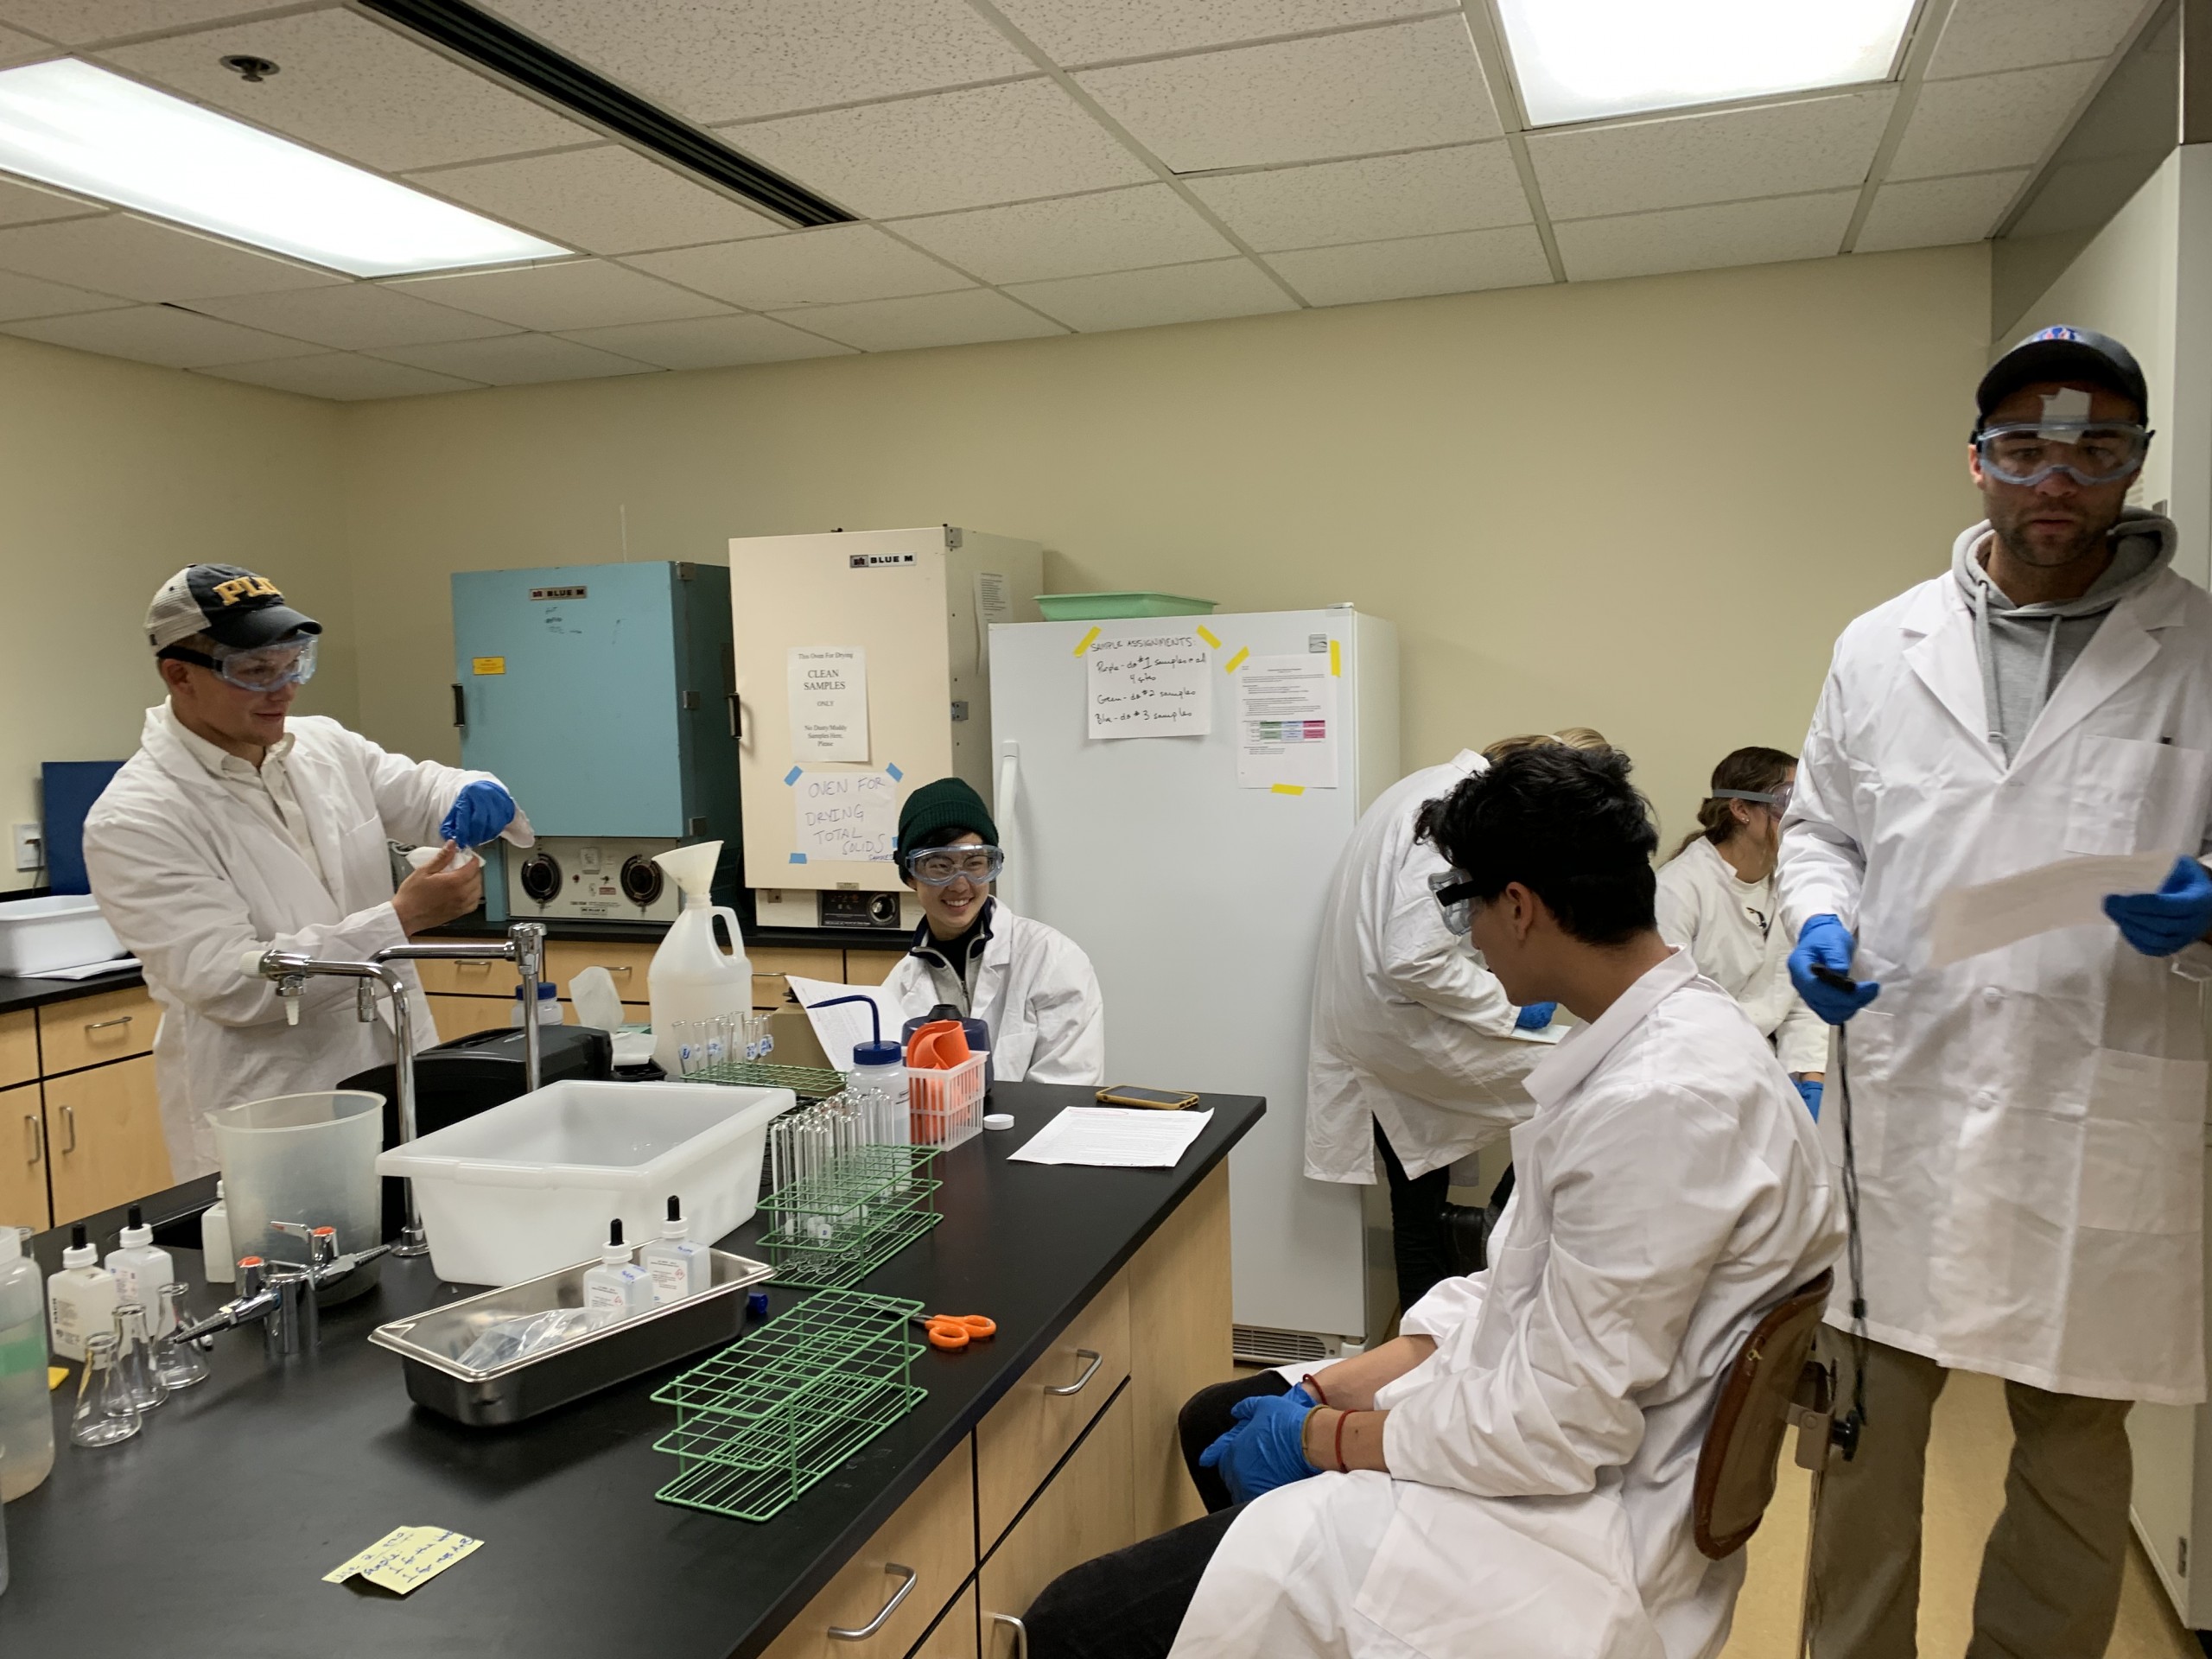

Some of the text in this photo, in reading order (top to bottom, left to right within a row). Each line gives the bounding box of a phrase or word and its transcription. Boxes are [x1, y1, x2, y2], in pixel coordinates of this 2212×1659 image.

[1090, 640, 1123, 652] SAMPLE
[808, 670, 840, 678] CLEAN
[804, 681, 846, 690] SAMPLES
[808, 777, 885, 798] OVEN FOR
[805, 804, 864, 826] DRYING
[813, 827, 863, 844] TOTAL
[842, 833, 885, 855] SOLIDS
